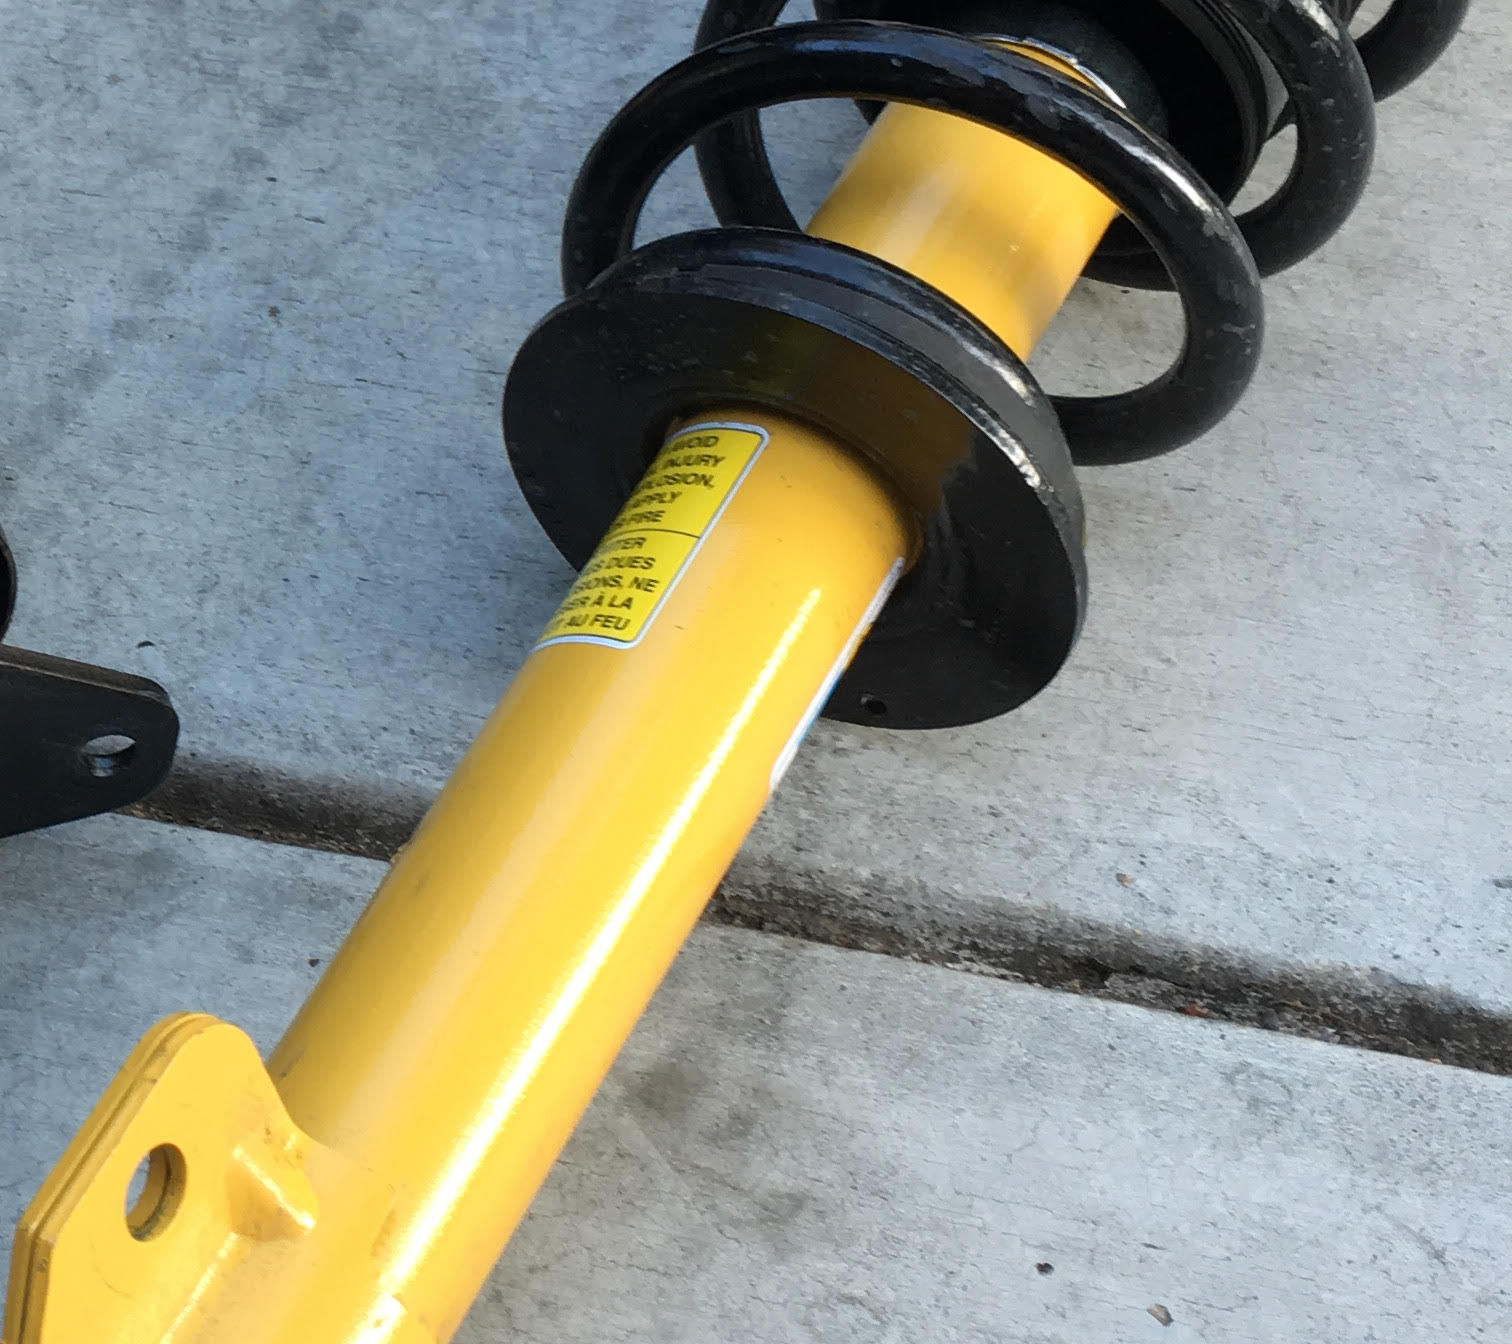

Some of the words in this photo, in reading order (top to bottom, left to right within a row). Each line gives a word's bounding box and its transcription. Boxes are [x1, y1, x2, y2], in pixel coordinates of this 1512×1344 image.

[629, 576, 659, 593] NE
[607, 595, 633, 610] LA
[590, 614, 631, 630] FEU
